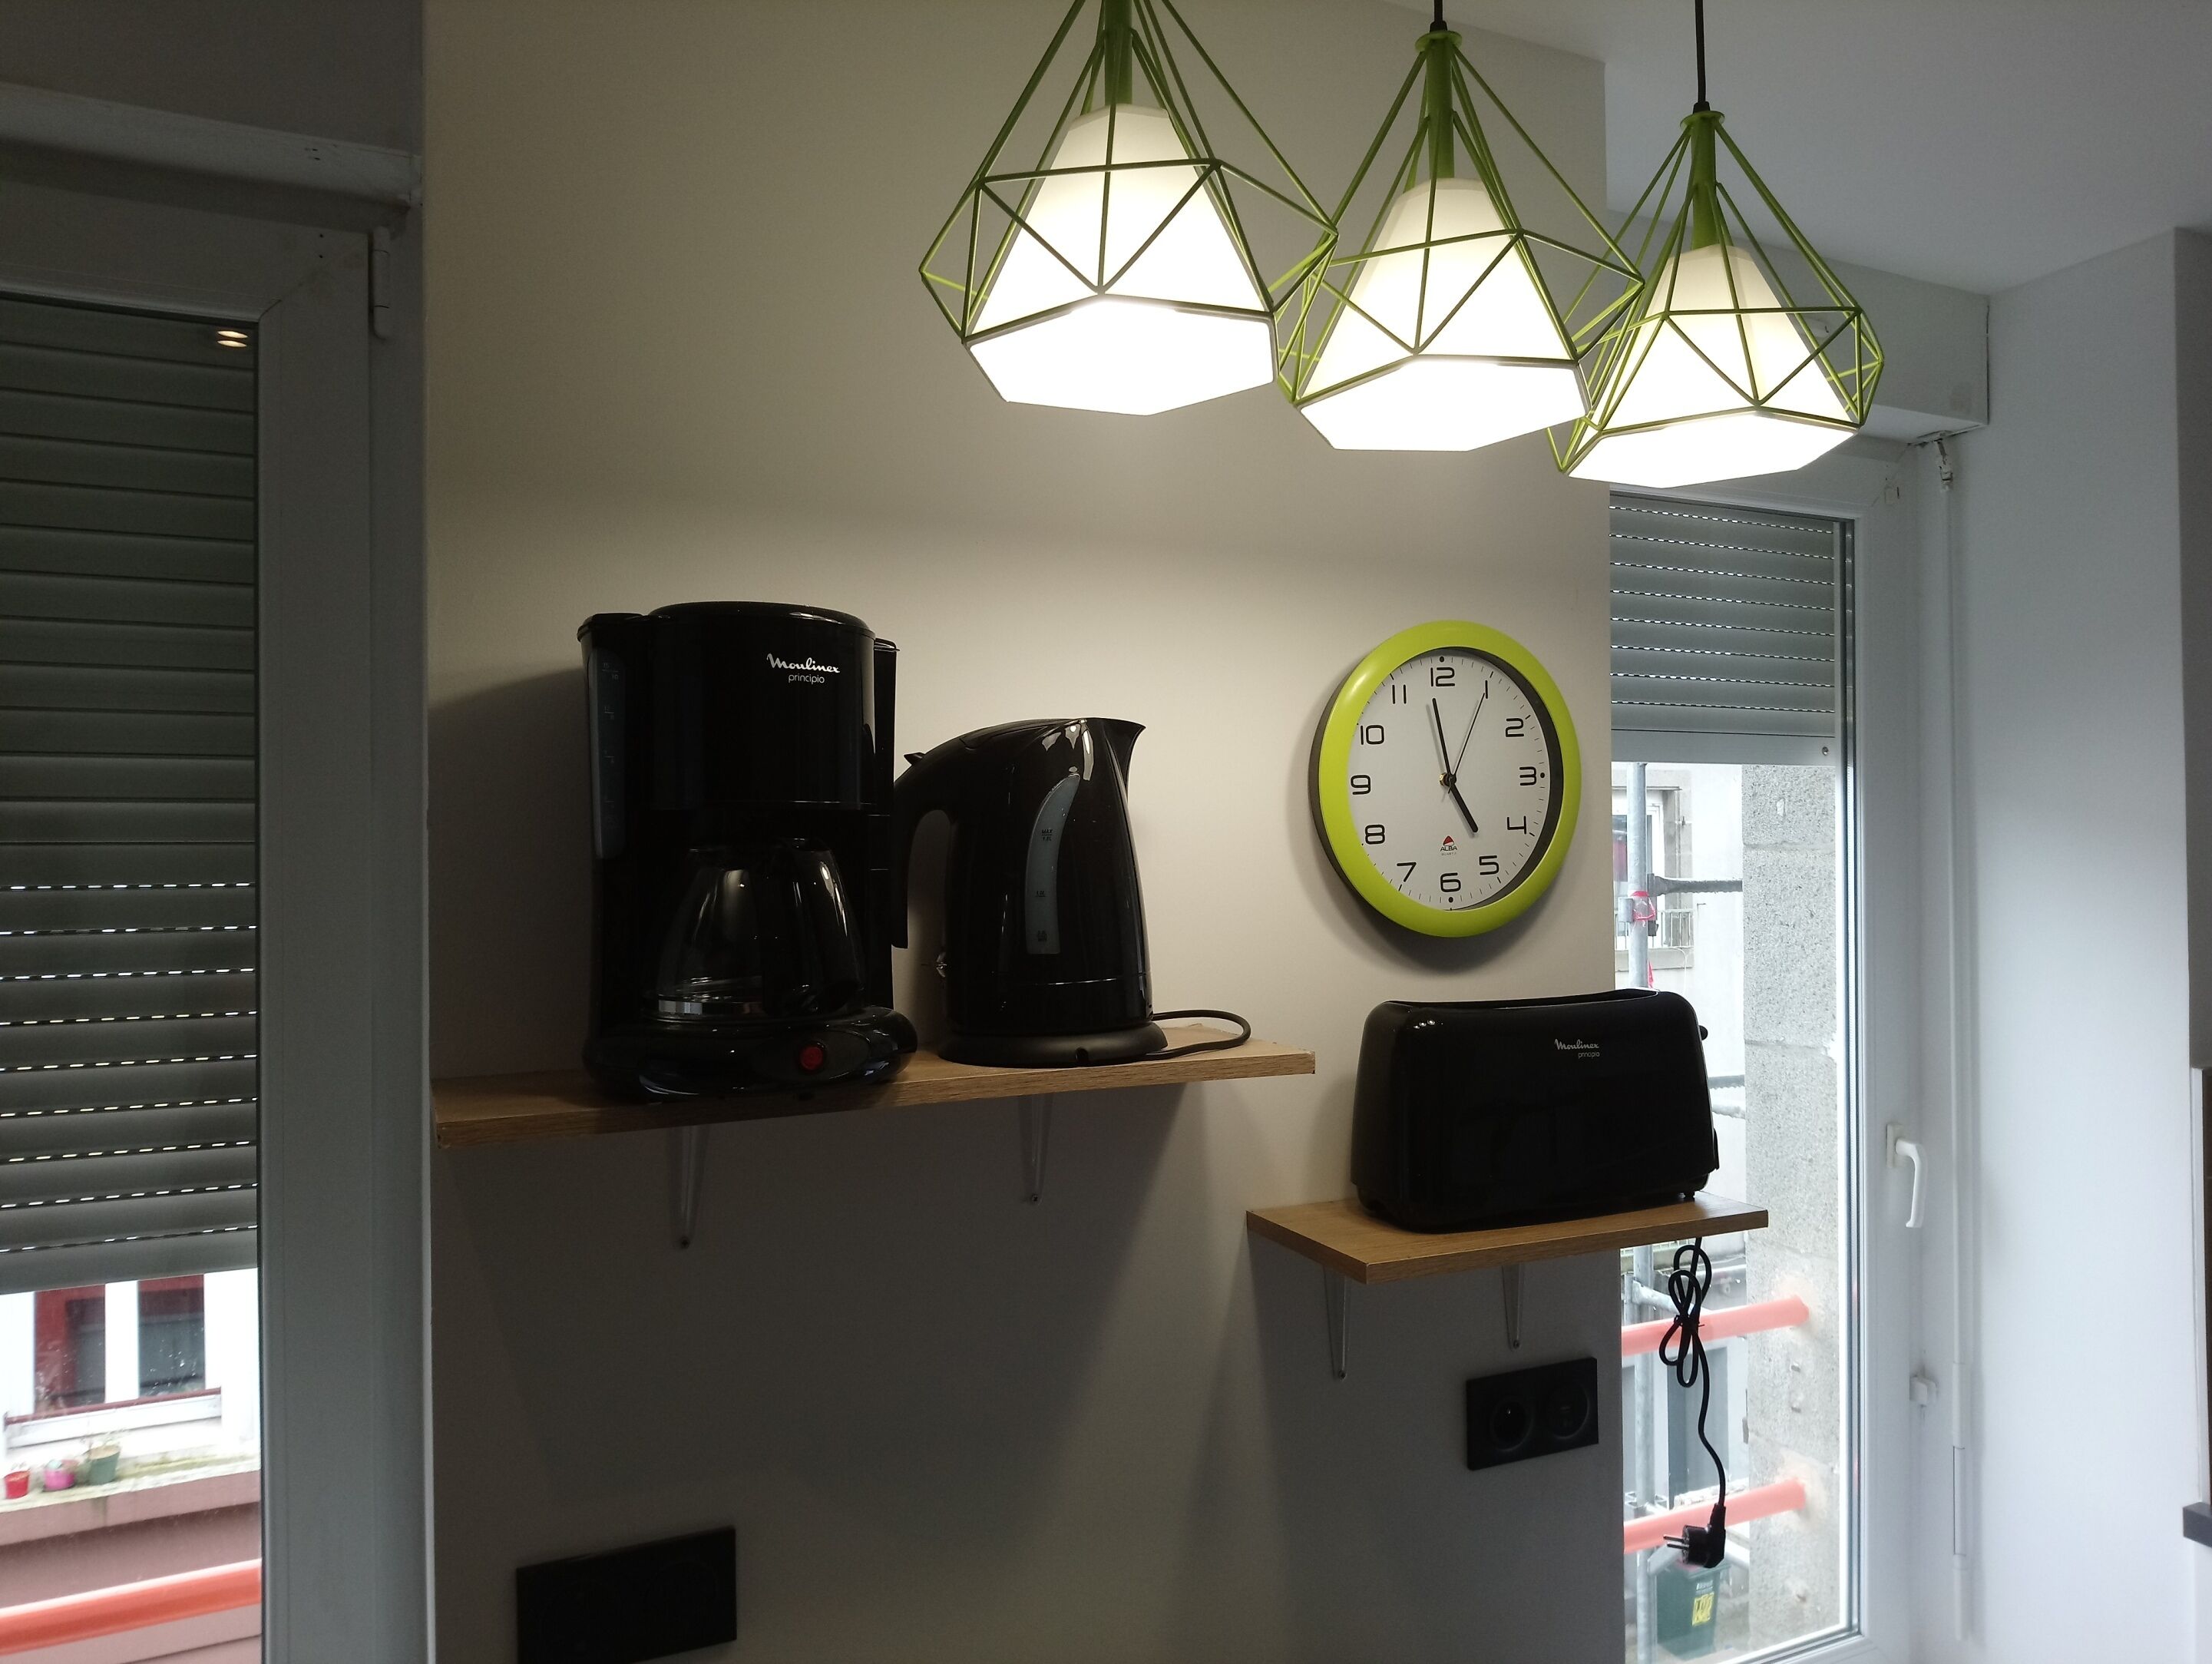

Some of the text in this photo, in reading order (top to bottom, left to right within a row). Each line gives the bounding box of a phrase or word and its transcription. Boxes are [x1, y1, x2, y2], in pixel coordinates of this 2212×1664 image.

[766, 653, 841, 673] Moulinex
[788, 673, 825, 685] principio
[1430, 667, 1456, 687] 12
[1391, 684, 1407, 704] 11
[1360, 724, 1385, 745] 10
[1505, 717, 1525, 738] 2
[1350, 774, 1371, 796] 9
[1519, 766, 1537, 786] 3
[1364, 824, 1385, 845] 8
[1506, 815, 1527, 835] 4
[1396, 862, 1417, 882] 7
[1479, 855, 1500, 875] 5
[1440, 872, 1462, 892] 6
[1554, 1038, 1600, 1050] Moulinex
